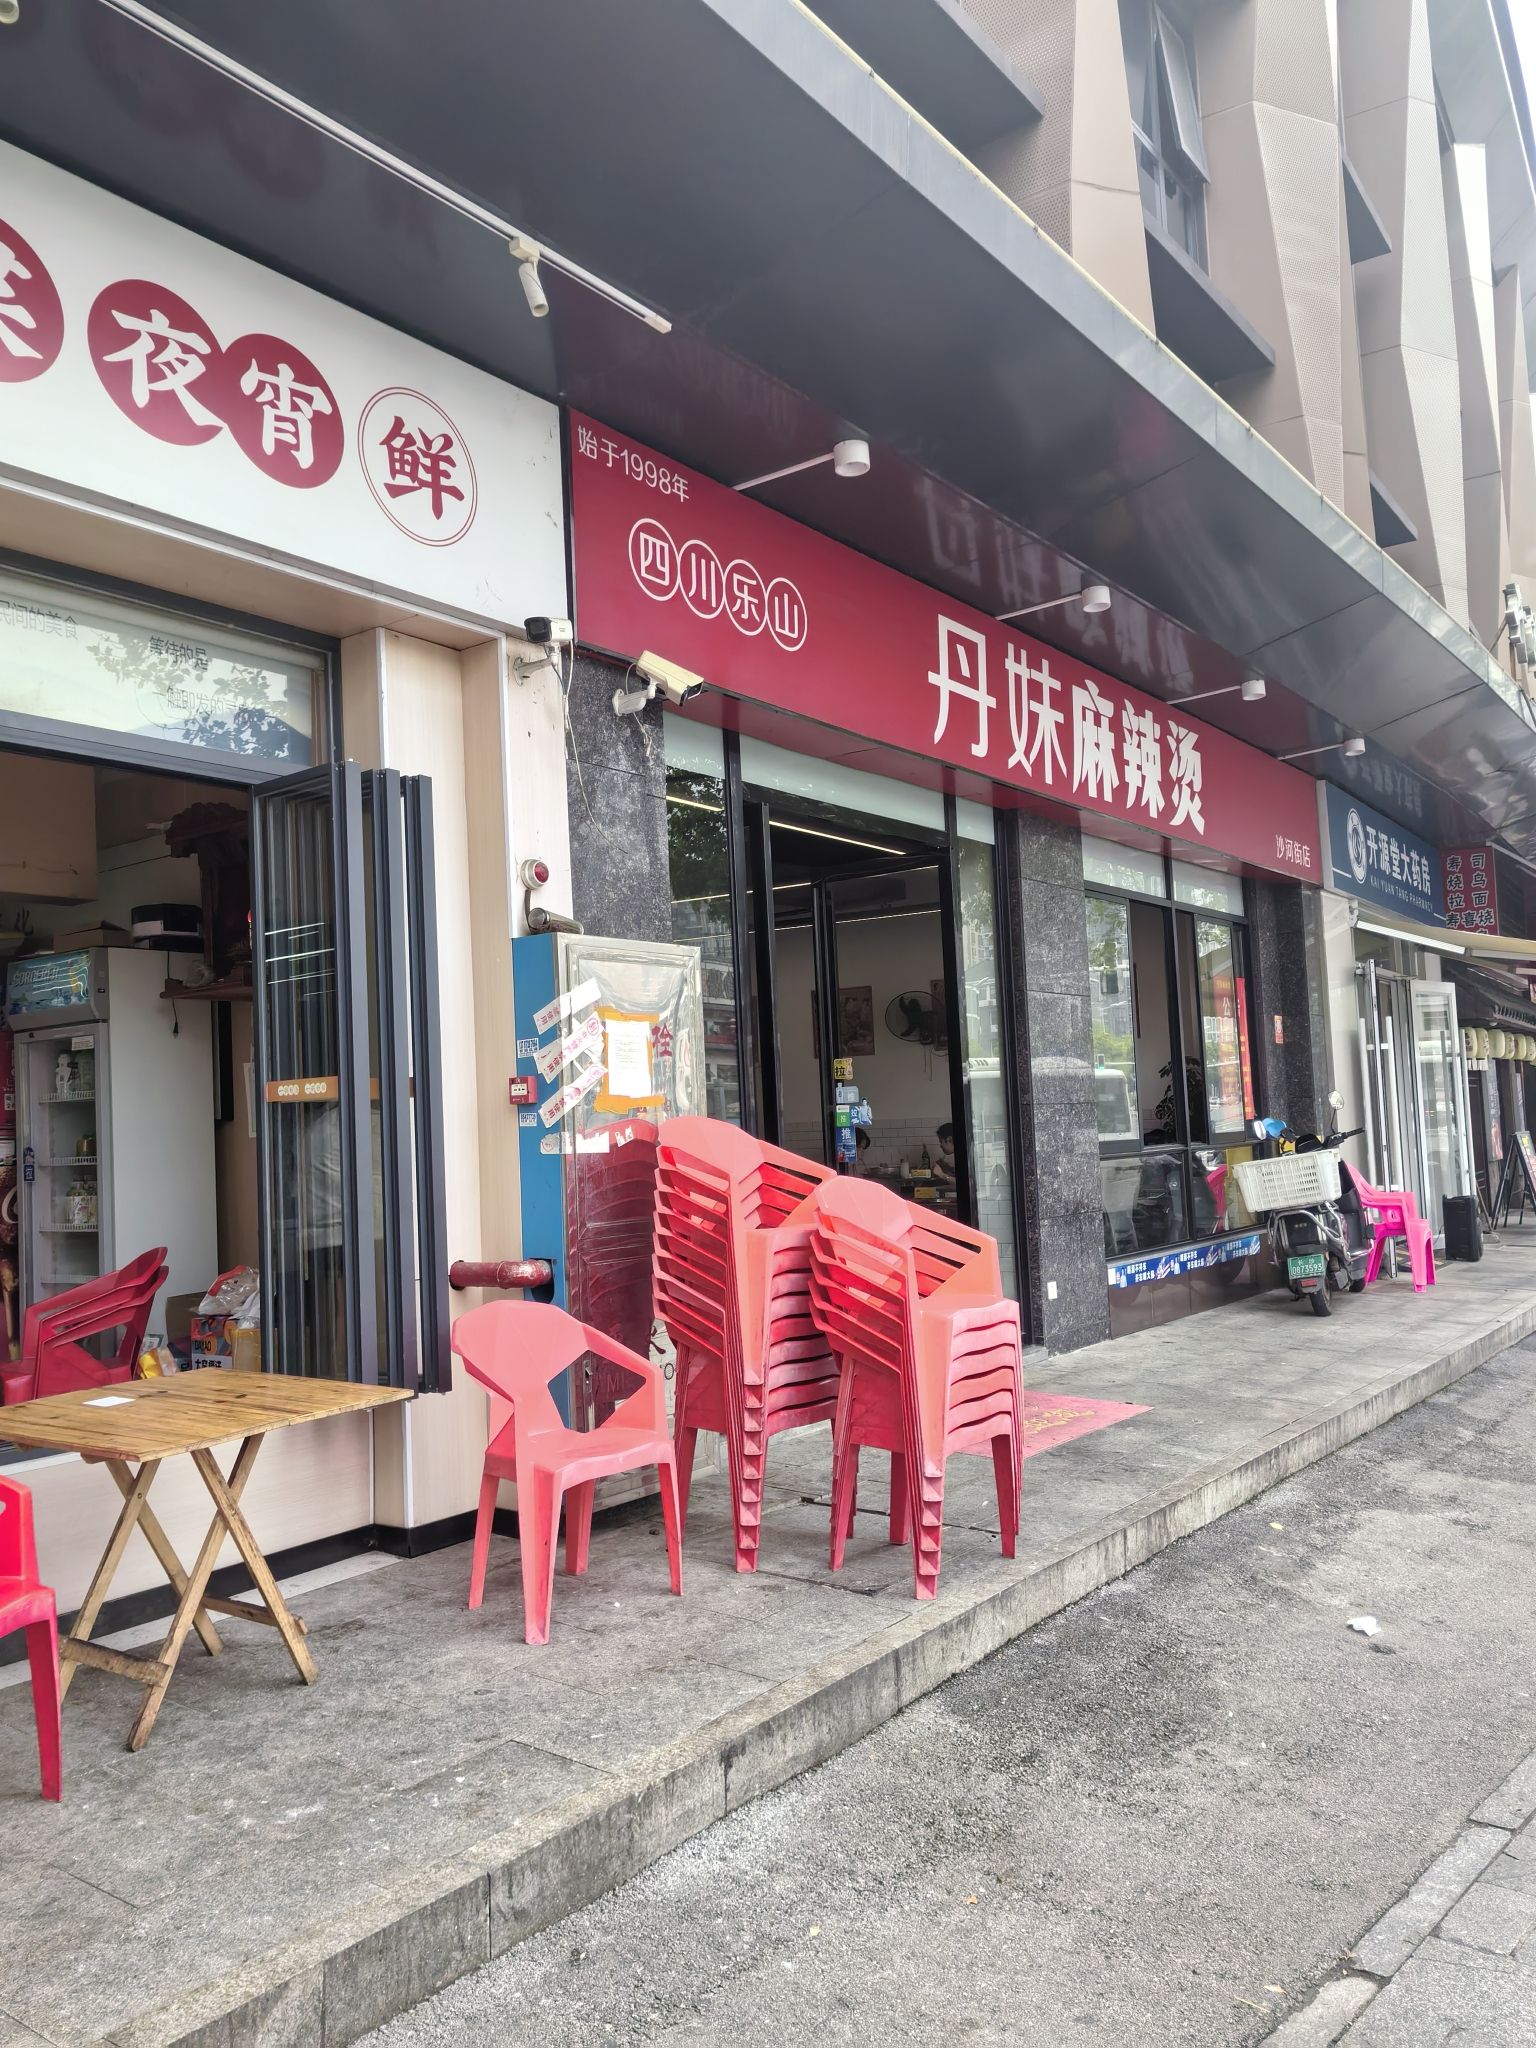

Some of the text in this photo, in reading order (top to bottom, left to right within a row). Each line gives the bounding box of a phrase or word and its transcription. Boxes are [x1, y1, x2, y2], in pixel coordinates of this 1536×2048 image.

[379, 415, 465, 521] 鲜
[577, 424, 690, 503] 始于1998年
[636, 528, 800, 641] 四川乐山
[927, 612, 1206, 836] 丹妹麻辣烫
[1275, 833, 1311, 868] 沙河街店
[1365, 825, 1432, 897] 开源堂大药房
[1446, 908, 1495, 928] 寿喜烧
[1292, 1263, 1322, 1275] 0873593
